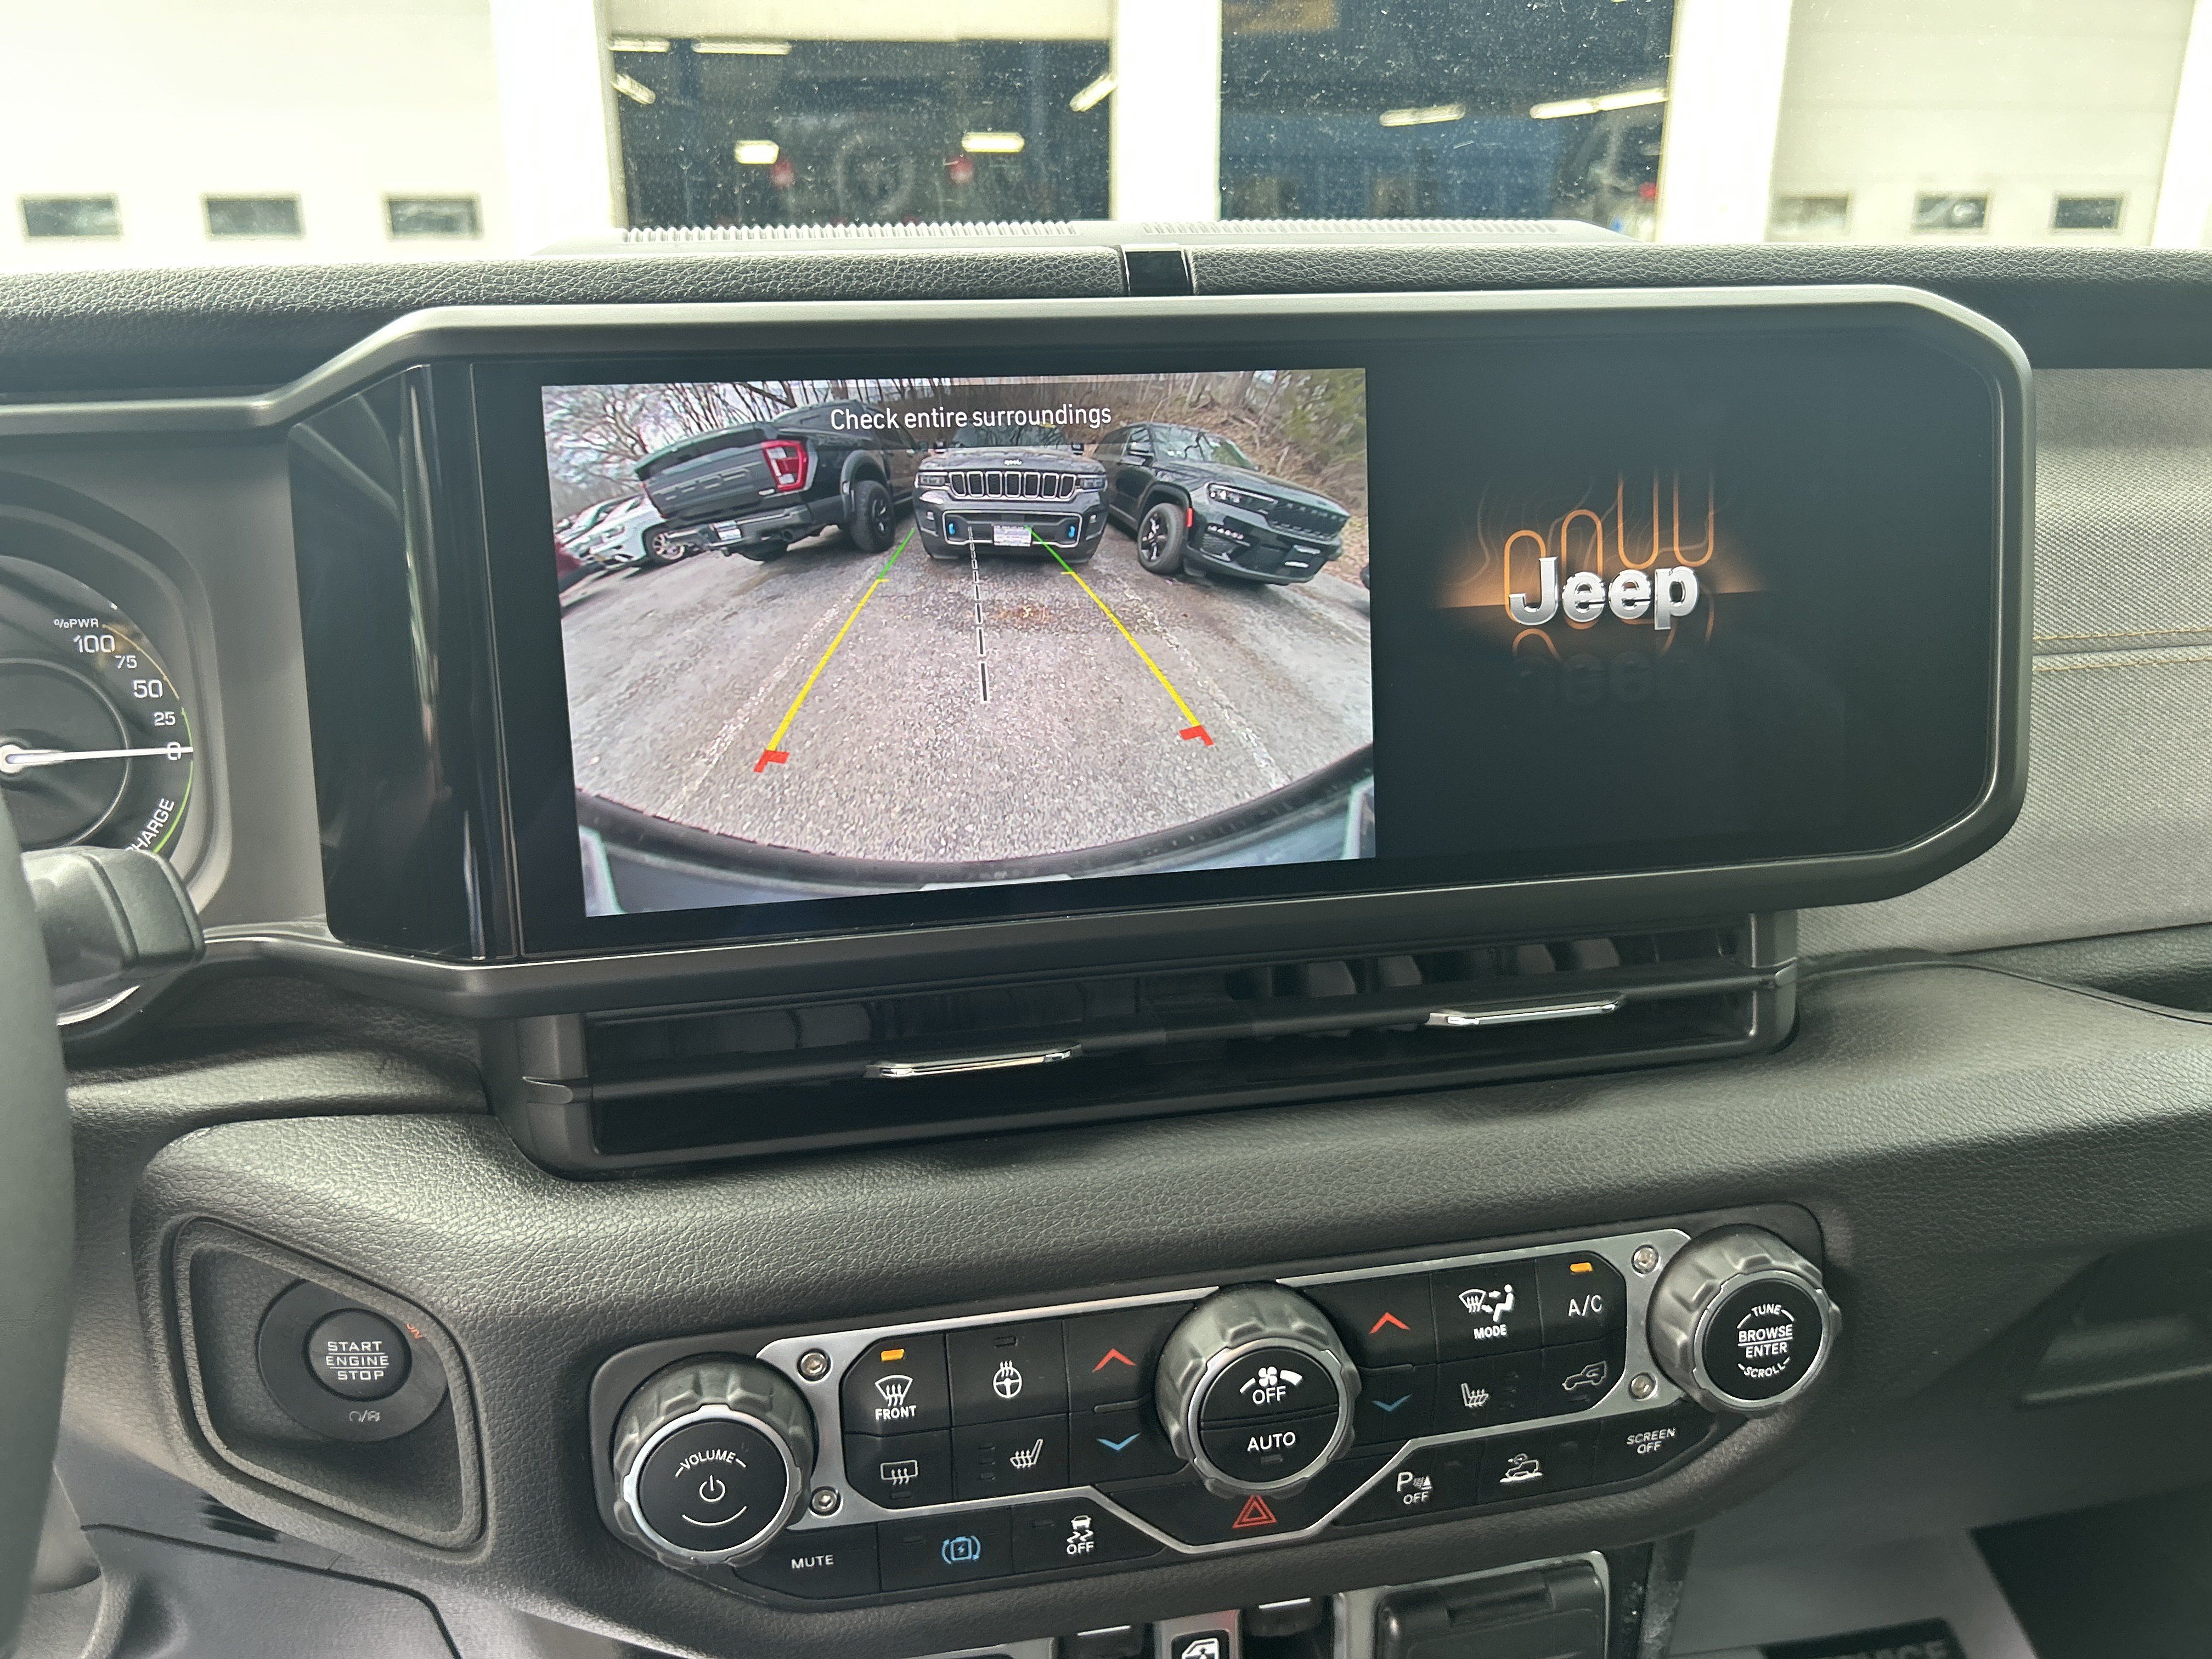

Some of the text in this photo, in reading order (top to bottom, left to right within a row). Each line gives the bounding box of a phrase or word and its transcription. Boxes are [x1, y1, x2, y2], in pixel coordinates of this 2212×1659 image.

[830, 403, 1111, 431] Check entire surroundings
[1508, 557, 1699, 630] Jeep
[54, 618, 99, 628] %PWR
[73, 635, 115, 653] 100
[115, 655, 137, 669] 75
[133, 680, 163, 698] 50
[154, 712, 176, 726] 25
[167, 742, 181, 761] 0
[1568, 1294, 1602, 1316] A/C
[1751, 1304, 1781, 1317] TUNE
[1474, 1324, 1507, 1339] MODE
[1739, 1324, 1793, 1342] BROWSE
[328, 1341, 382, 1351] START
[1746, 1342, 1787, 1358] ENTER
[326, 1356, 389, 1365] ENGINE
[337, 1370, 384, 1380] STOP
[1743, 1363, 1785, 1378] SCROLL
[1252, 1386, 1286, 1404] OFF
[875, 1406, 916, 1421] FRONT
[1247, 1432, 1296, 1452] AUTO
[1627, 1427, 1675, 1444] SCREEN
[1637, 1441, 1662, 1454] OFF
[681, 1449, 736, 1470] VOLUME
[1397, 1471, 1413, 1492] P
[1403, 1491, 1429, 1504] OFF
[1066, 1542, 1094, 1555] OFF
[791, 1555, 834, 1568] MUTE
